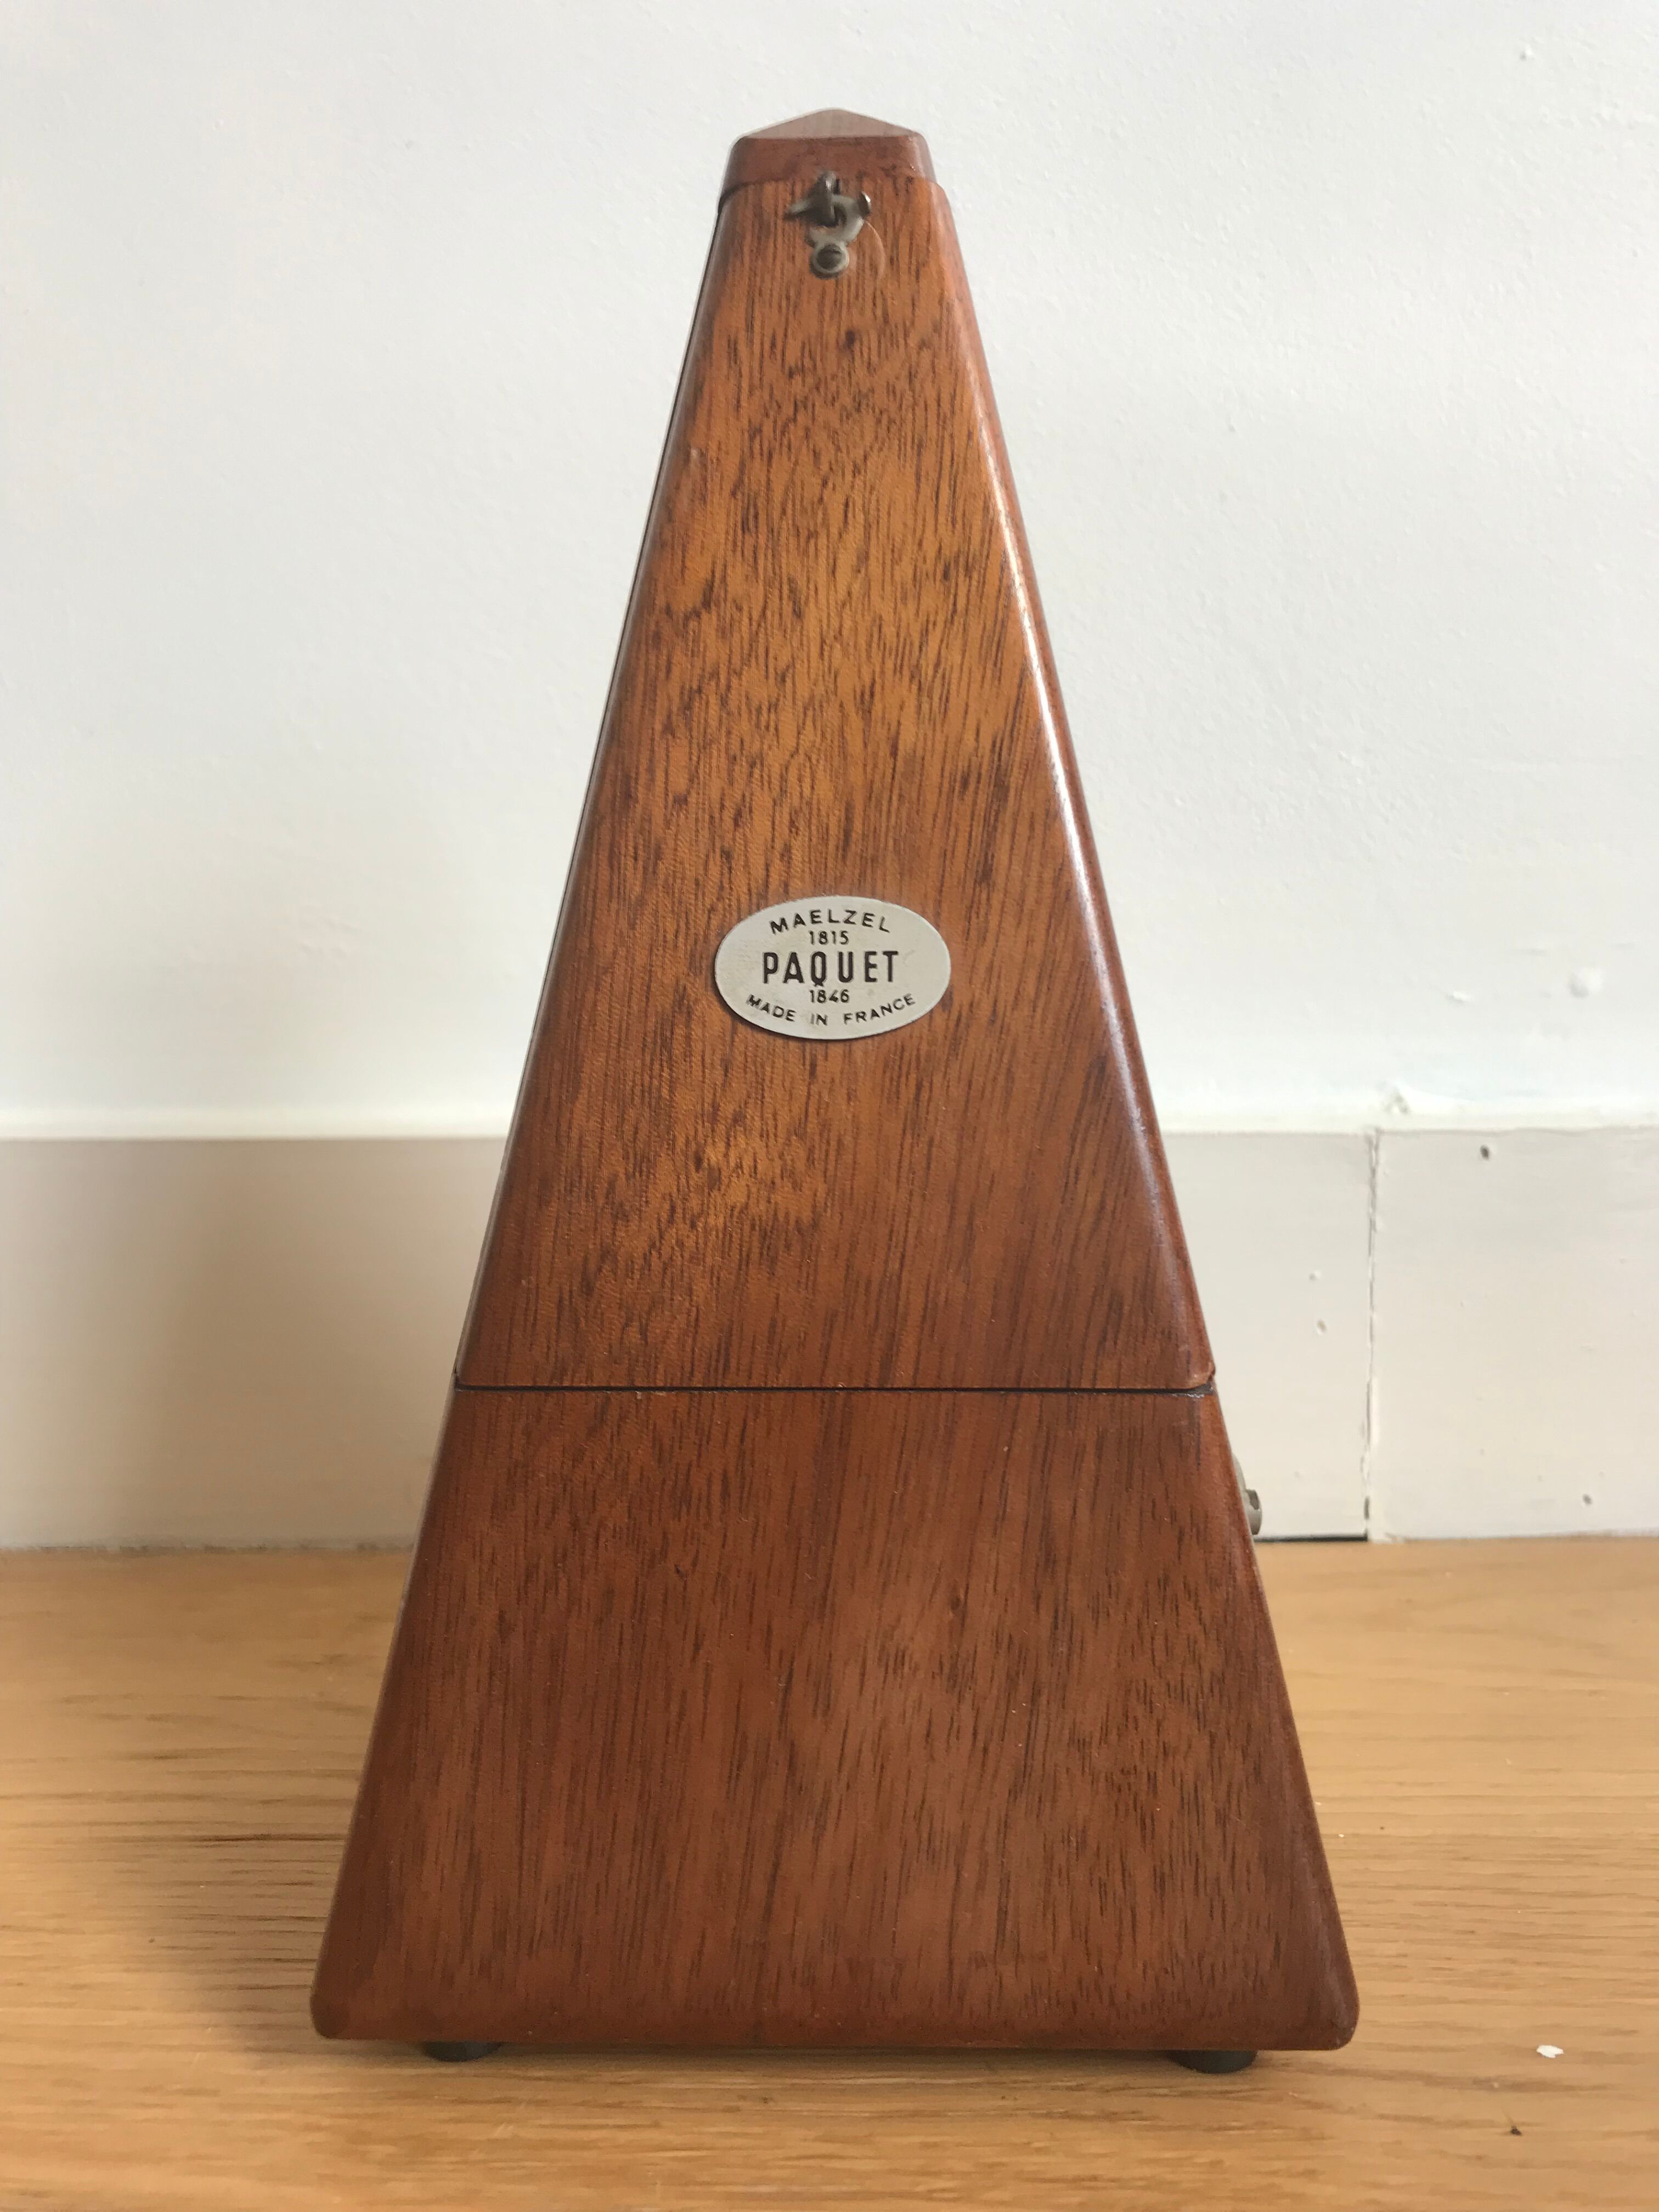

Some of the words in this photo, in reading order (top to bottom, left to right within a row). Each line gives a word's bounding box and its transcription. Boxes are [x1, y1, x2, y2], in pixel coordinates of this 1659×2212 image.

[769, 909, 890, 935] MAELZEL
[809, 930, 850, 945] 1815
[763, 951, 899, 987] PAQUET
[747, 994, 797, 1022] MADE
[810, 1013, 828, 1025] IN
[843, 994, 916, 1025] FRANCE
[809, 989, 850, 1004] 1846
